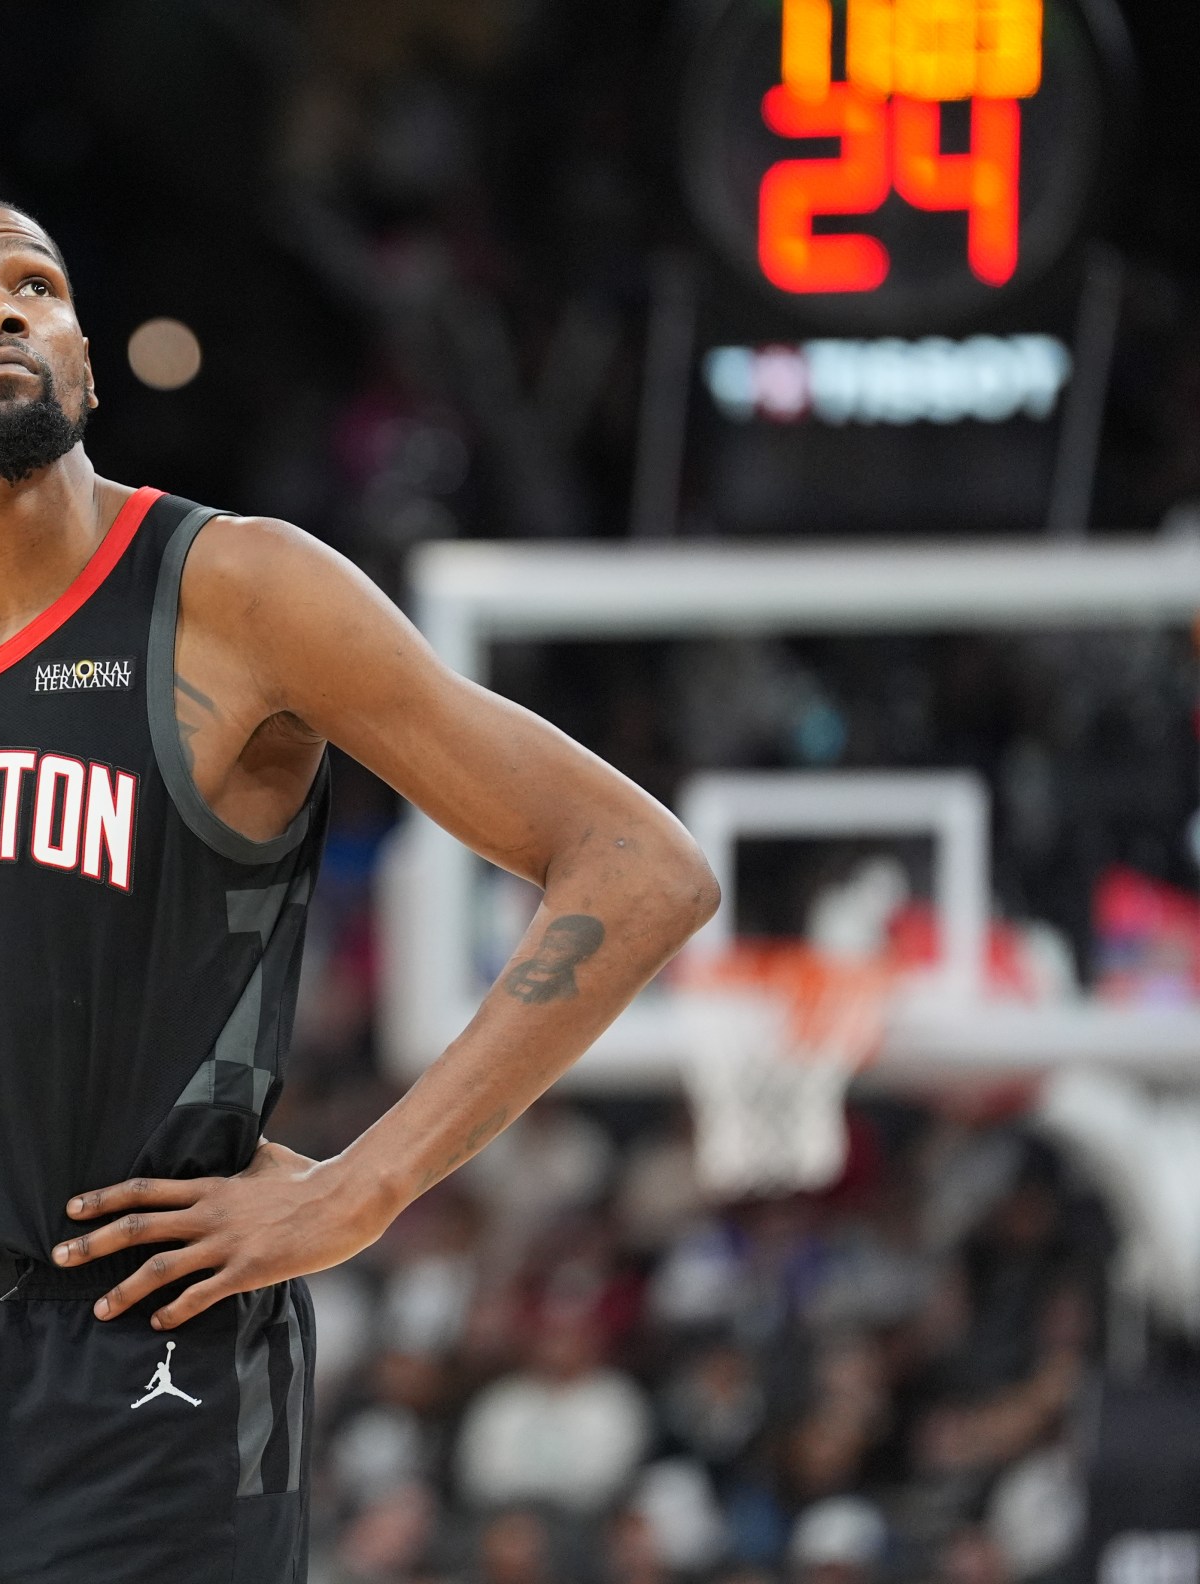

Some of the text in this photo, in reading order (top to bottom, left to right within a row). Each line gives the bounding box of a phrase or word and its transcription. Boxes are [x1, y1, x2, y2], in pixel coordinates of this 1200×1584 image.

[759, 82, 1020, 293] 24
[35, 660, 132, 679] MEMORIAL
[34, 673, 130, 691] HERMANN
